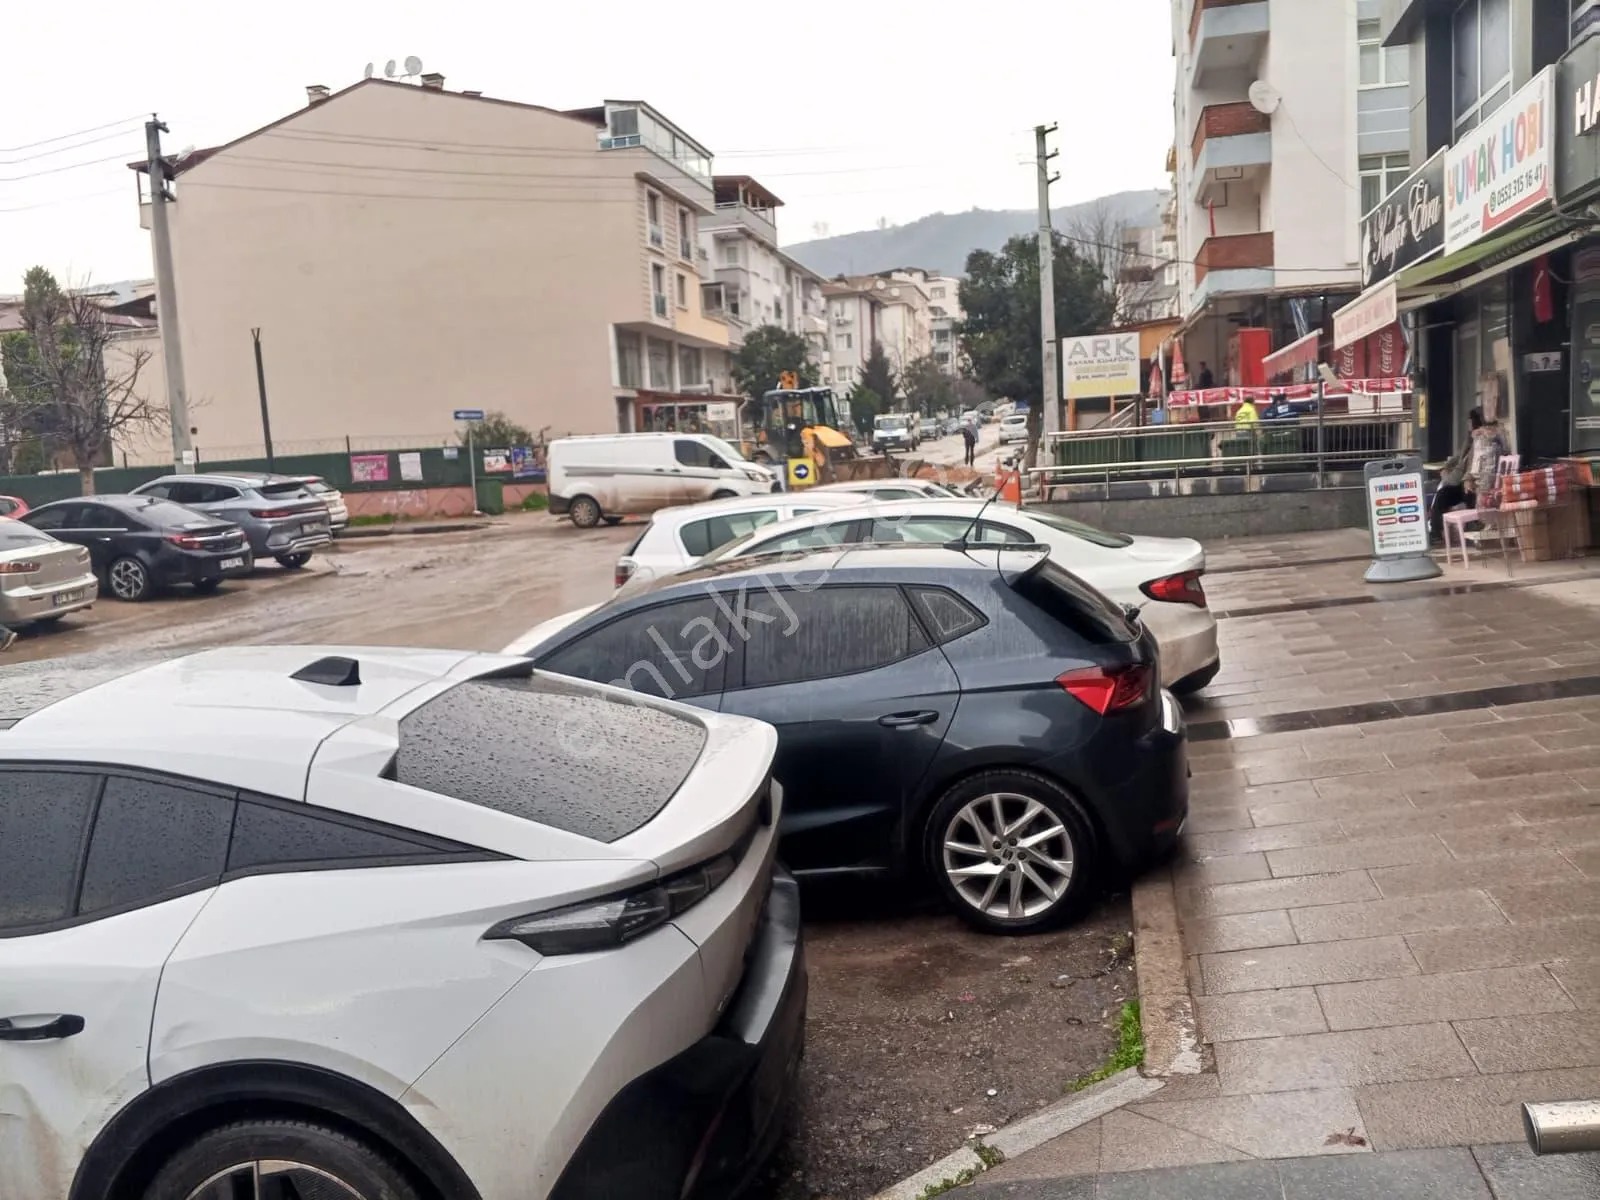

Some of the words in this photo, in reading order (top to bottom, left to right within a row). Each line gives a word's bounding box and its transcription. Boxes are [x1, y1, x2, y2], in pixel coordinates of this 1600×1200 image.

[1447, 134, 1497, 211] YUMAK
[1497, 183, 1512, 206] 0552
[1512, 174, 1524, 197] 315
[1525, 169, 1534, 189] 16
[1068, 336, 1135, 359] ARK
